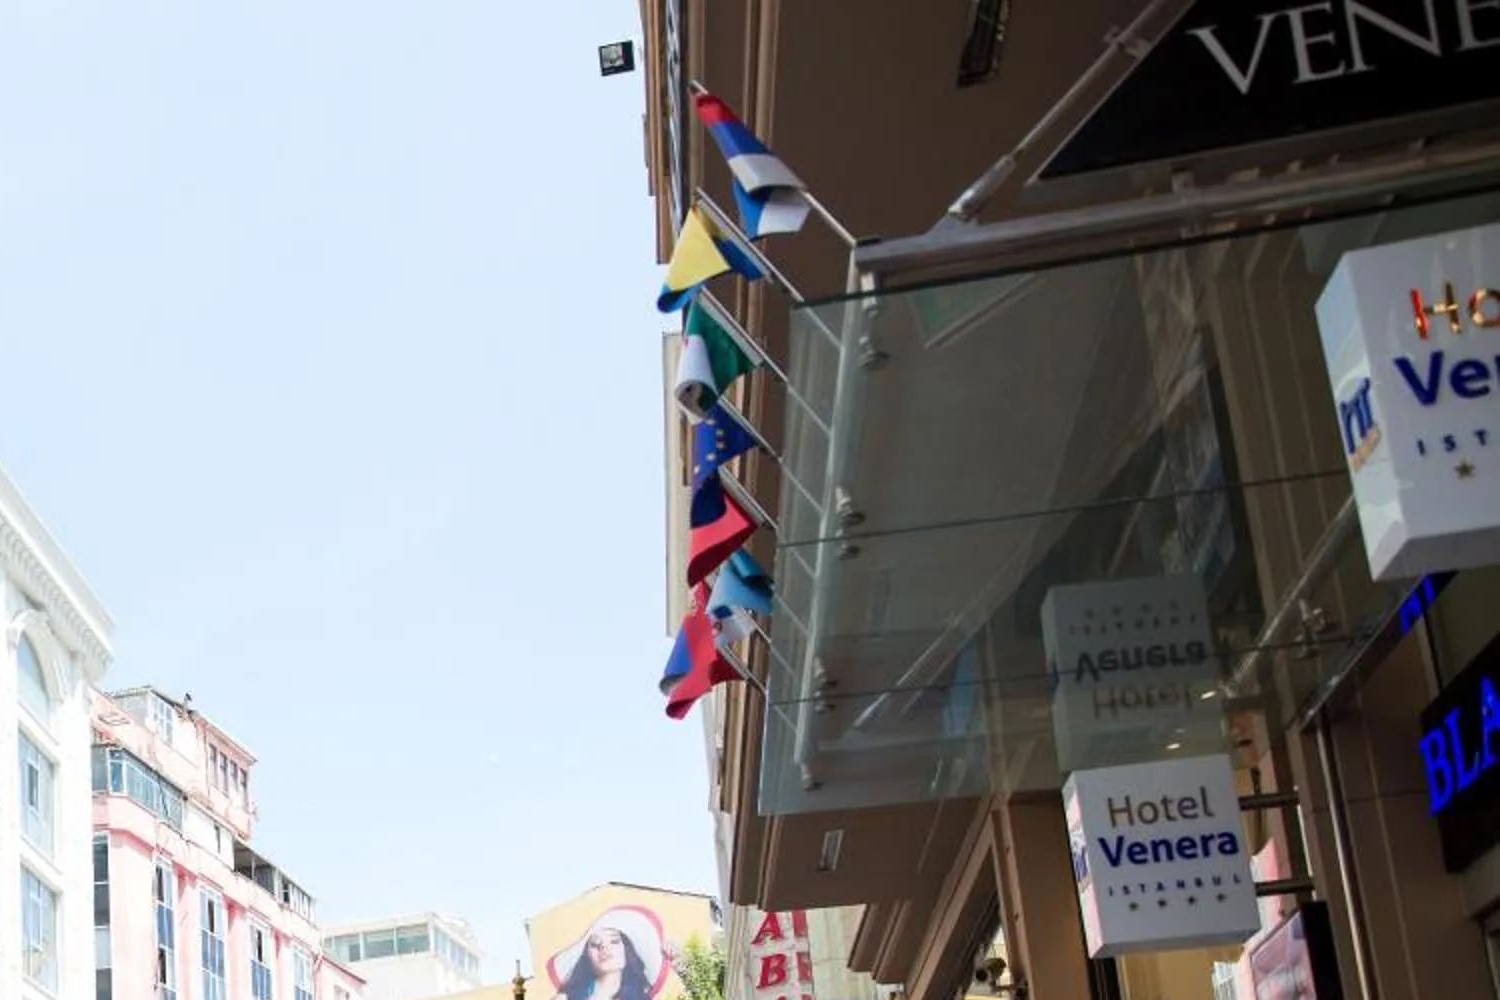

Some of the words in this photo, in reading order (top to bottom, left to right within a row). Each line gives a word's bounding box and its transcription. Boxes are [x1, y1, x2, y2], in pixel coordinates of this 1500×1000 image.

[1394, 351, 1500, 407] Ve
[1107, 785, 1215, 828] Hotel
[1098, 831, 1240, 868] Venera
